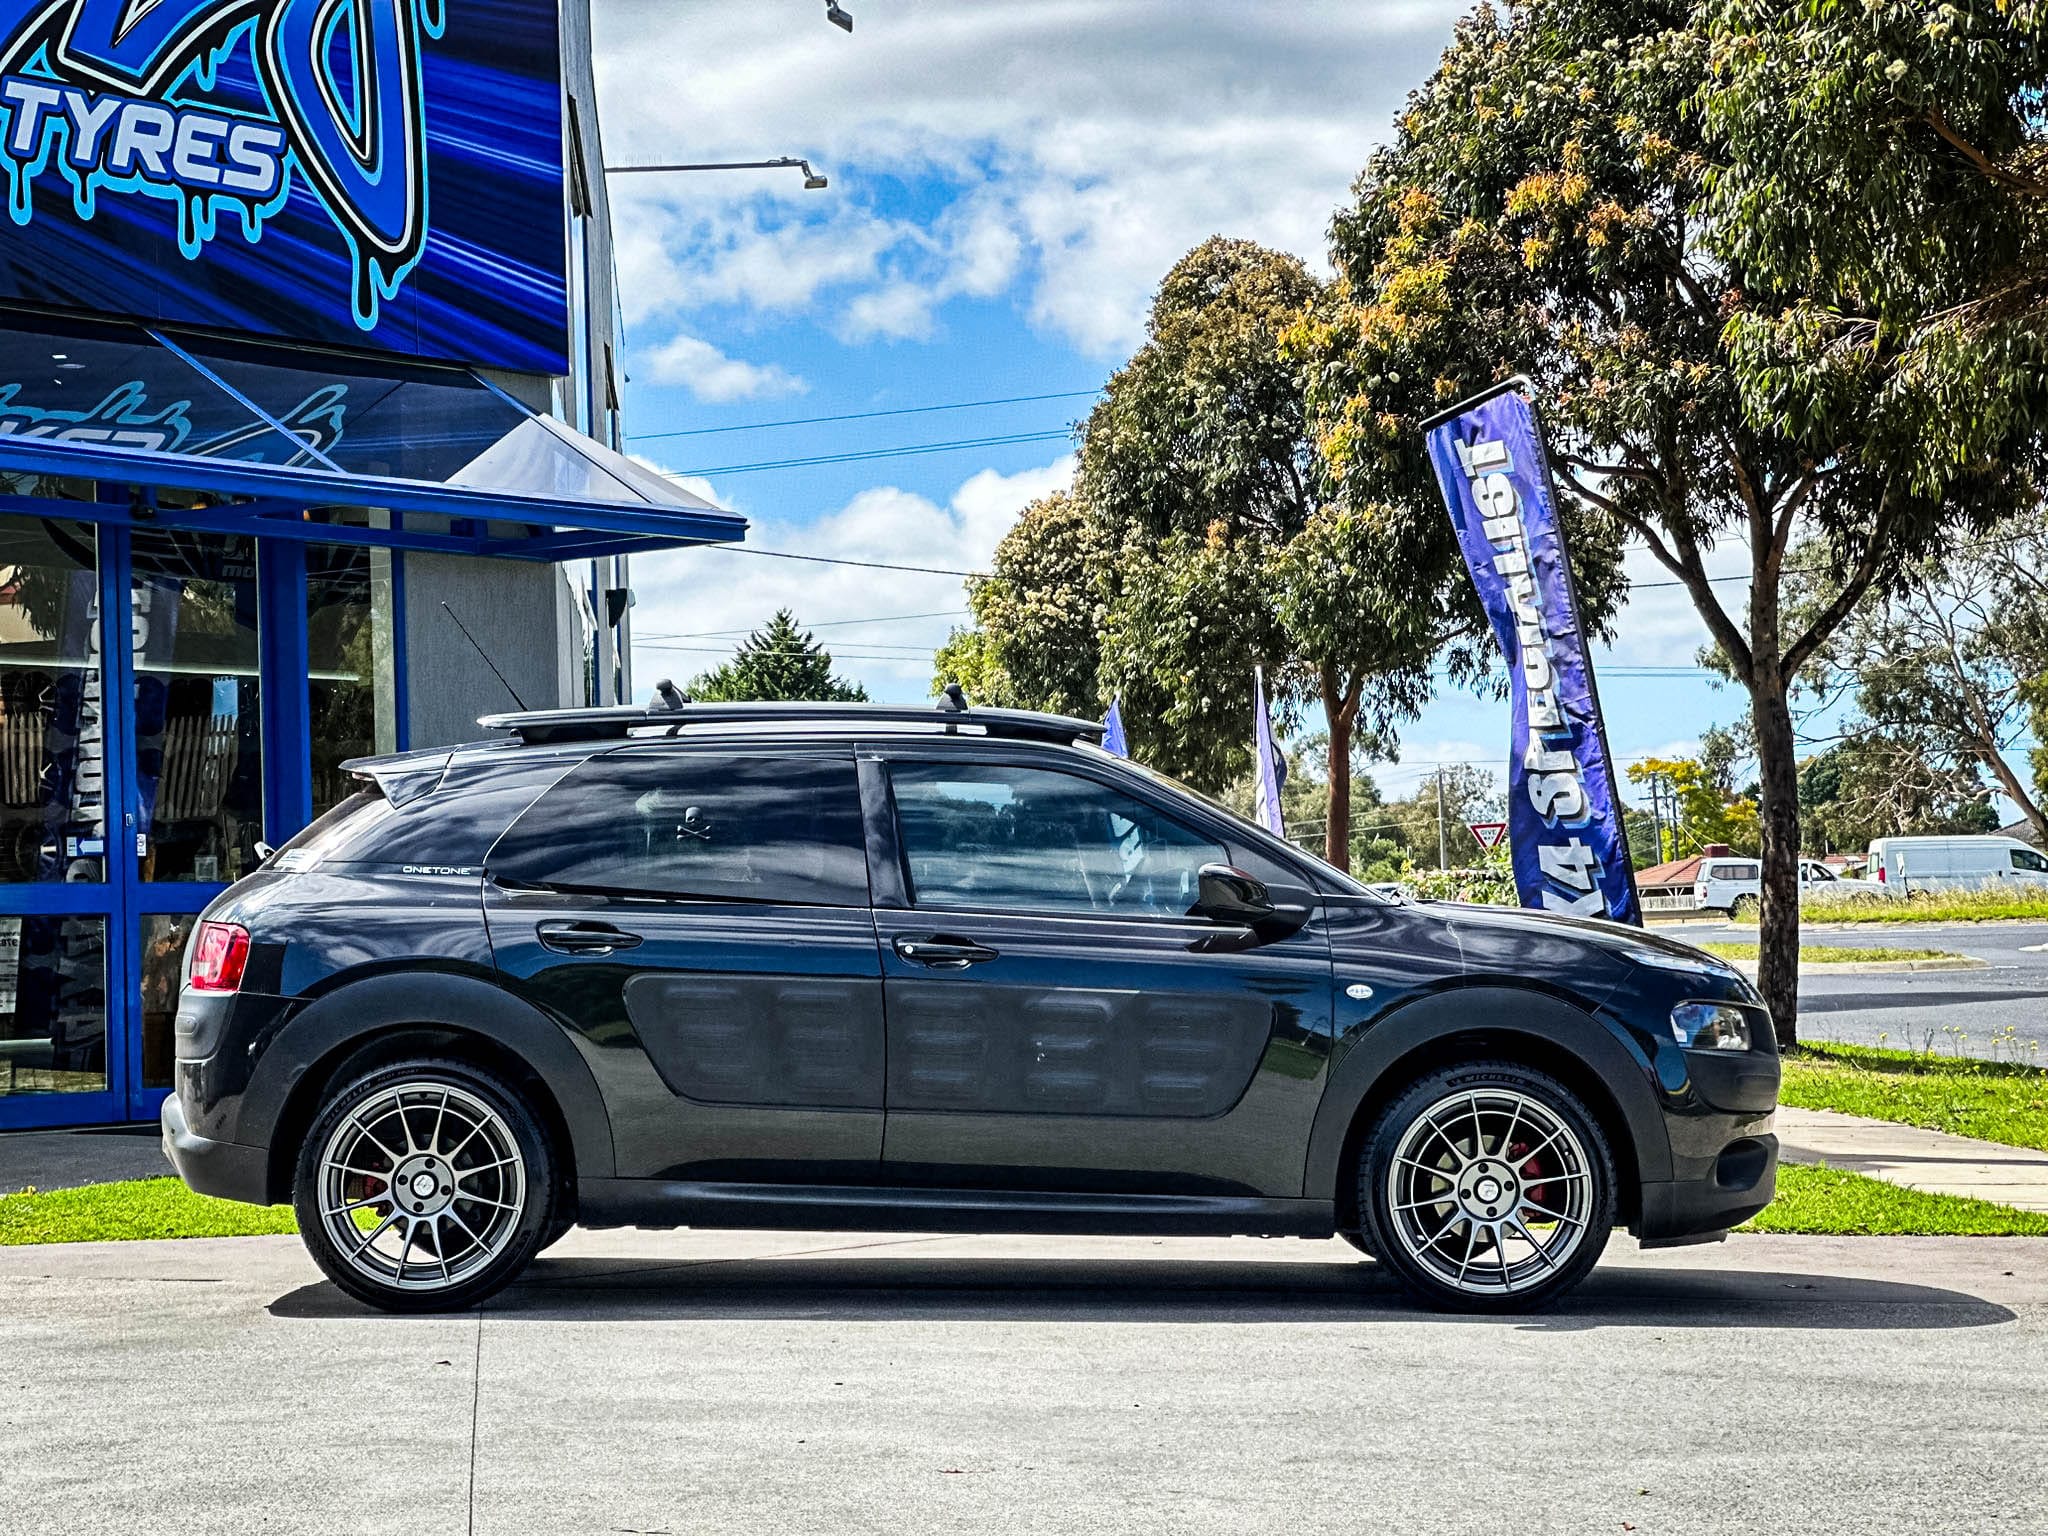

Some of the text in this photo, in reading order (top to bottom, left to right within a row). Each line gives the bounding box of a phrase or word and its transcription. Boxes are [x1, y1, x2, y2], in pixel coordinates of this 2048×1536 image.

[4, 80, 282, 193] TYRES
[1453, 438, 1605, 917] X4 SPECIALIST
[402, 865, 471, 875] ONETONE
[1464, 1073, 1526, 1085] MICHELIN
[324, 1081, 372, 1127] MICHELIN
